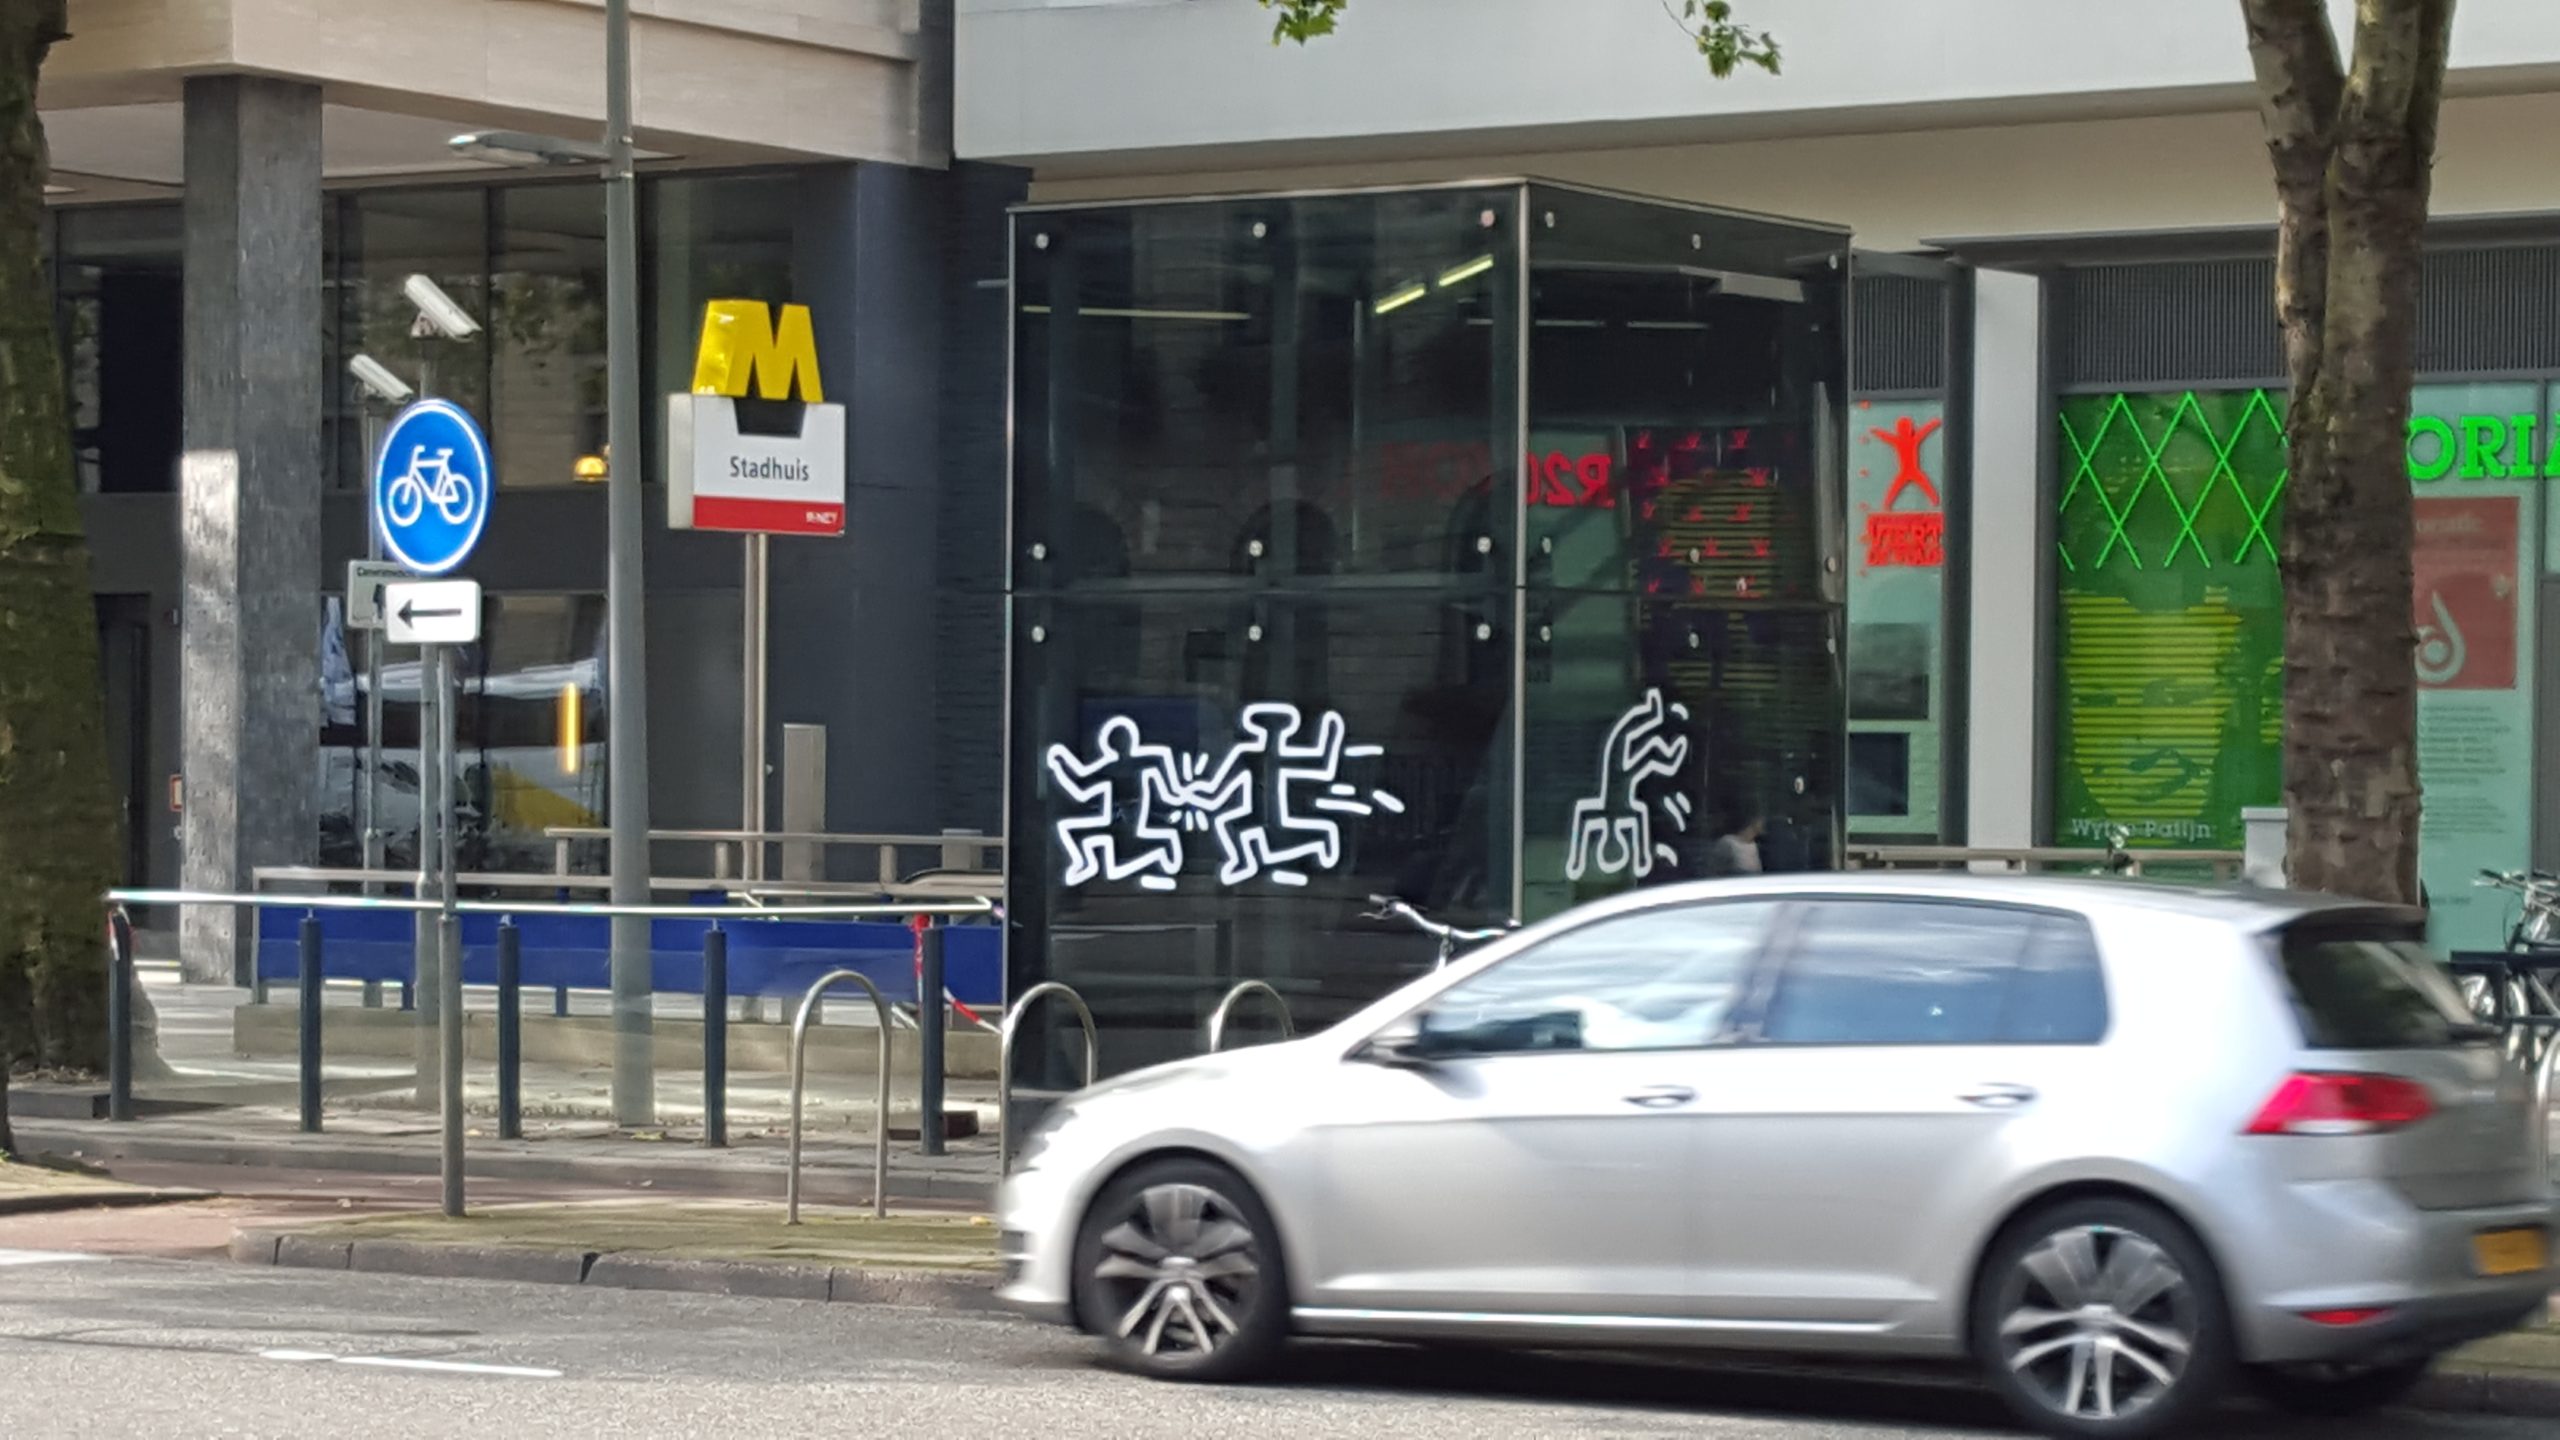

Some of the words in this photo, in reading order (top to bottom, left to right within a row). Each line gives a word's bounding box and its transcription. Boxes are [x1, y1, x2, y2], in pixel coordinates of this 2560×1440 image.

[694, 300, 823, 404] M
[730, 456, 810, 482] Stadhuis
[2072, 818, 2136, 841] Wyte
